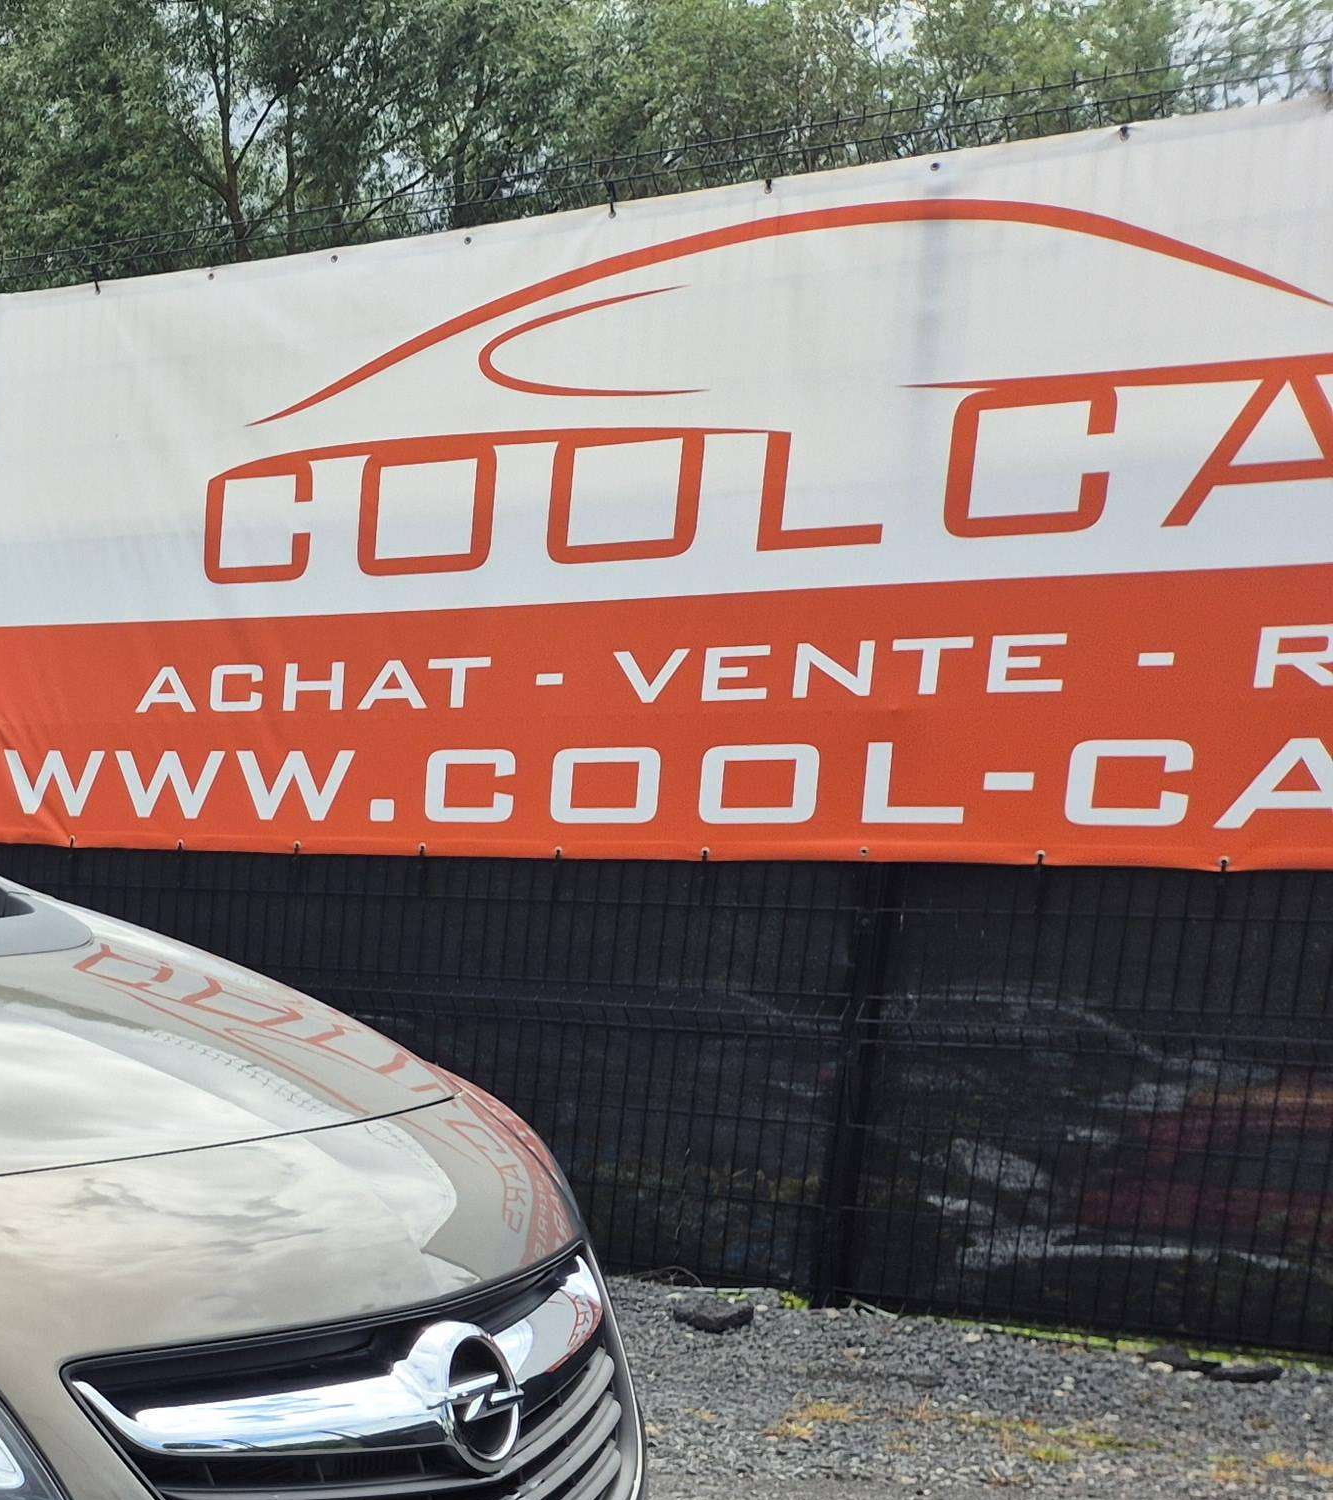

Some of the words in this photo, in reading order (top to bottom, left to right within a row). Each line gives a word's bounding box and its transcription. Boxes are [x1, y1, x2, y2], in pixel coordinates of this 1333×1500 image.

[203, 426, 883, 585] COOL
[135, 656, 492, 714] ACHAT
[613, 632, 1068, 704] VENTE
